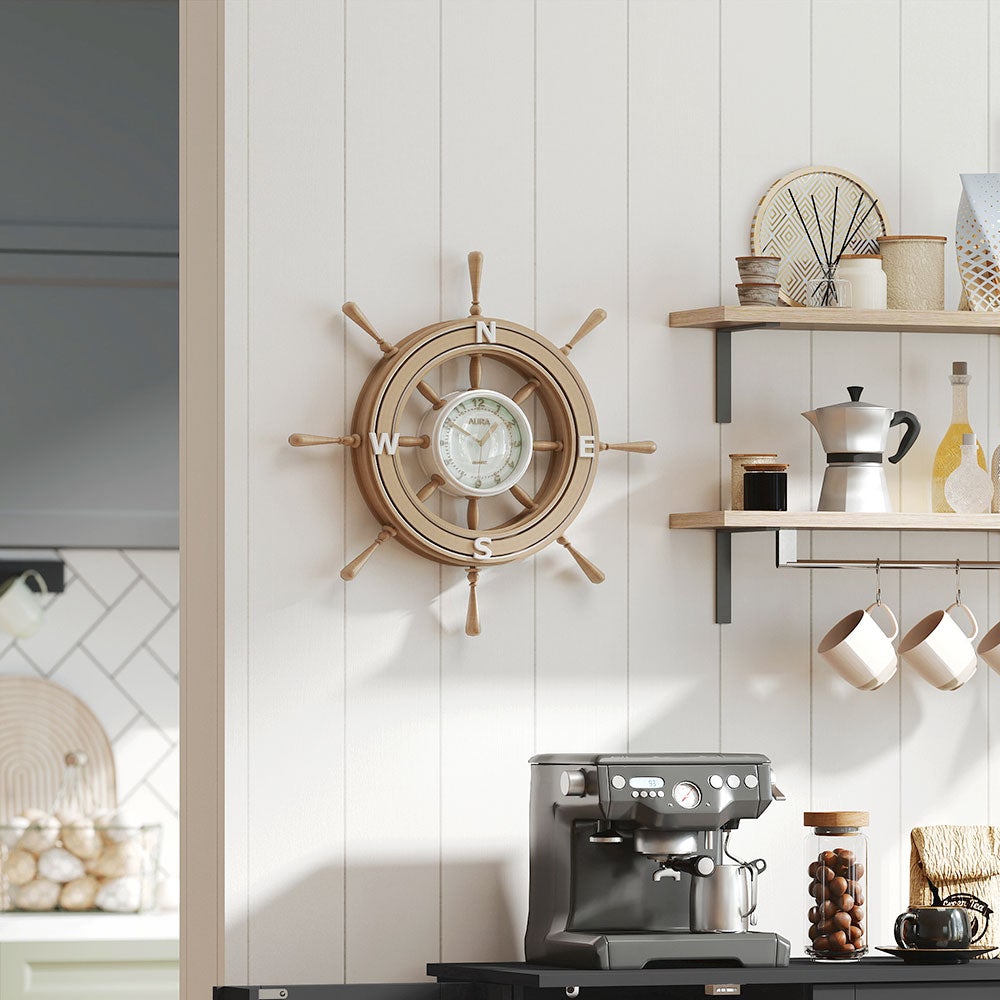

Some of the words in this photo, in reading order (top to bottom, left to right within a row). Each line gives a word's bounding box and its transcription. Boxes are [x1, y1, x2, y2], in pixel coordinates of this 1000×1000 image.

[475, 321, 497, 343] N
[472, 398, 485, 408] 12
[369, 432, 400, 455] W
[578, 435, 595, 458] E
[473, 537, 493, 560] S
[942, 898, 967, 907] Green
[969, 898, 985, 911] Tea
